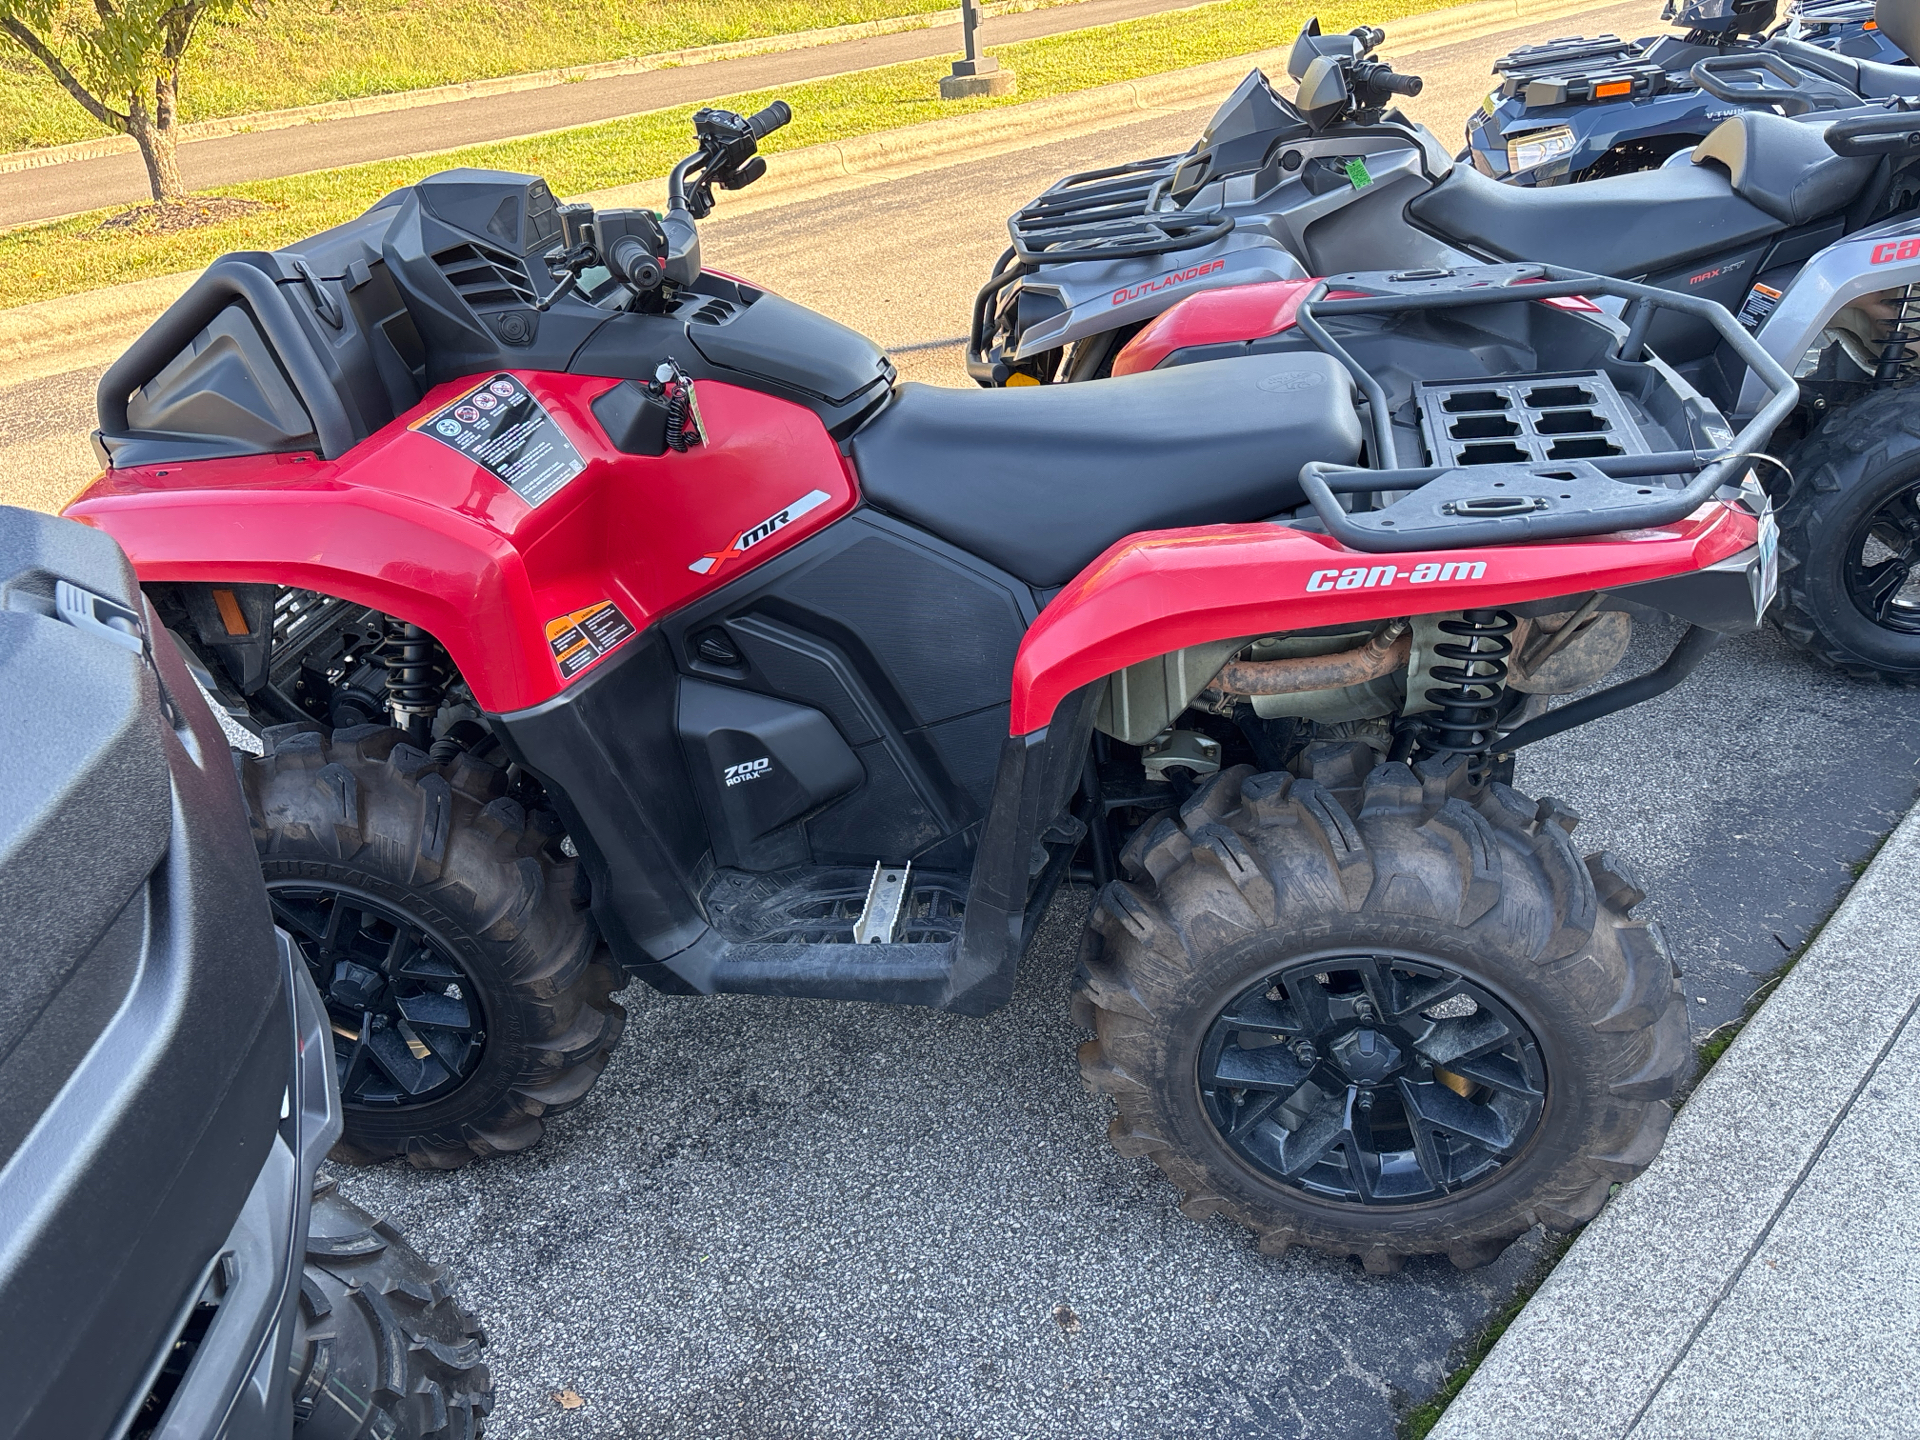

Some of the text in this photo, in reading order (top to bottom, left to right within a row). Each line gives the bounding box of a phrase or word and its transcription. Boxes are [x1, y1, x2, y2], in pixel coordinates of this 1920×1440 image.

[1112, 259, 1225, 306] OUTLANDER
[1689, 268, 1720, 285] MAX
[1305, 561, 1488, 593] can-am
[724, 757, 769, 780] 700
[725, 770, 760, 787] ROTAX
